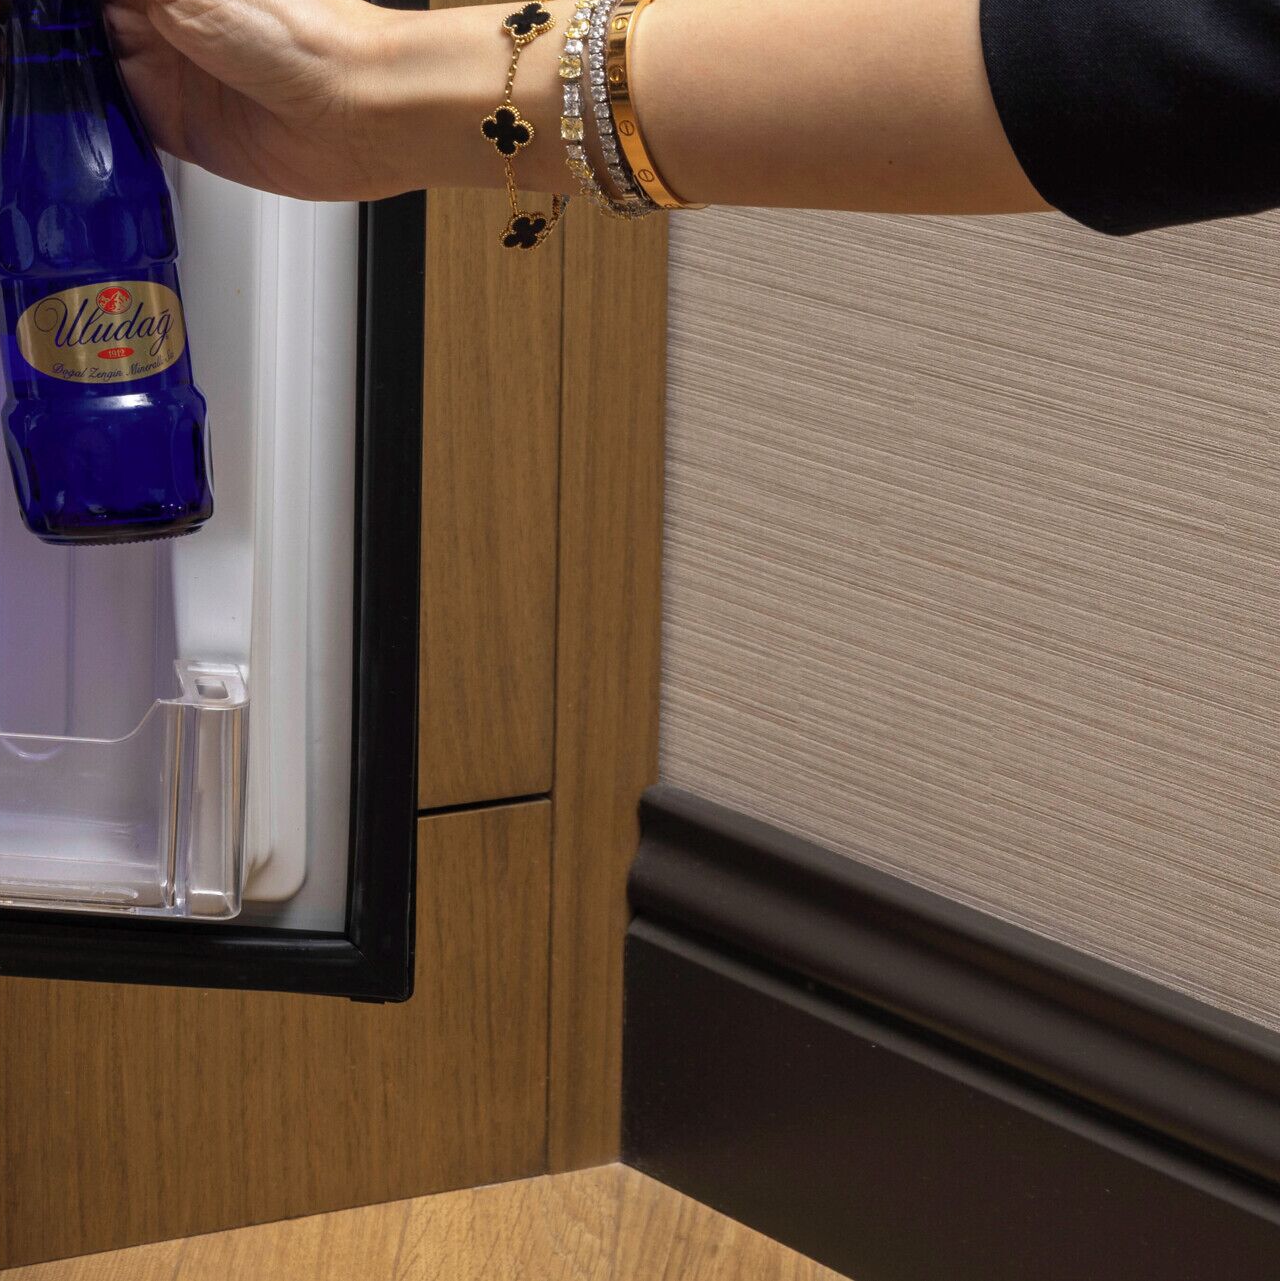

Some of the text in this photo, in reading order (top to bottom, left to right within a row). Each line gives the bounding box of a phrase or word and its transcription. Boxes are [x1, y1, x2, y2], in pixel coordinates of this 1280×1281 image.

[34, 298, 175, 357] Uludağ
[108, 348, 126, 358] 1912
[88, 368, 123, 382] Zengin
